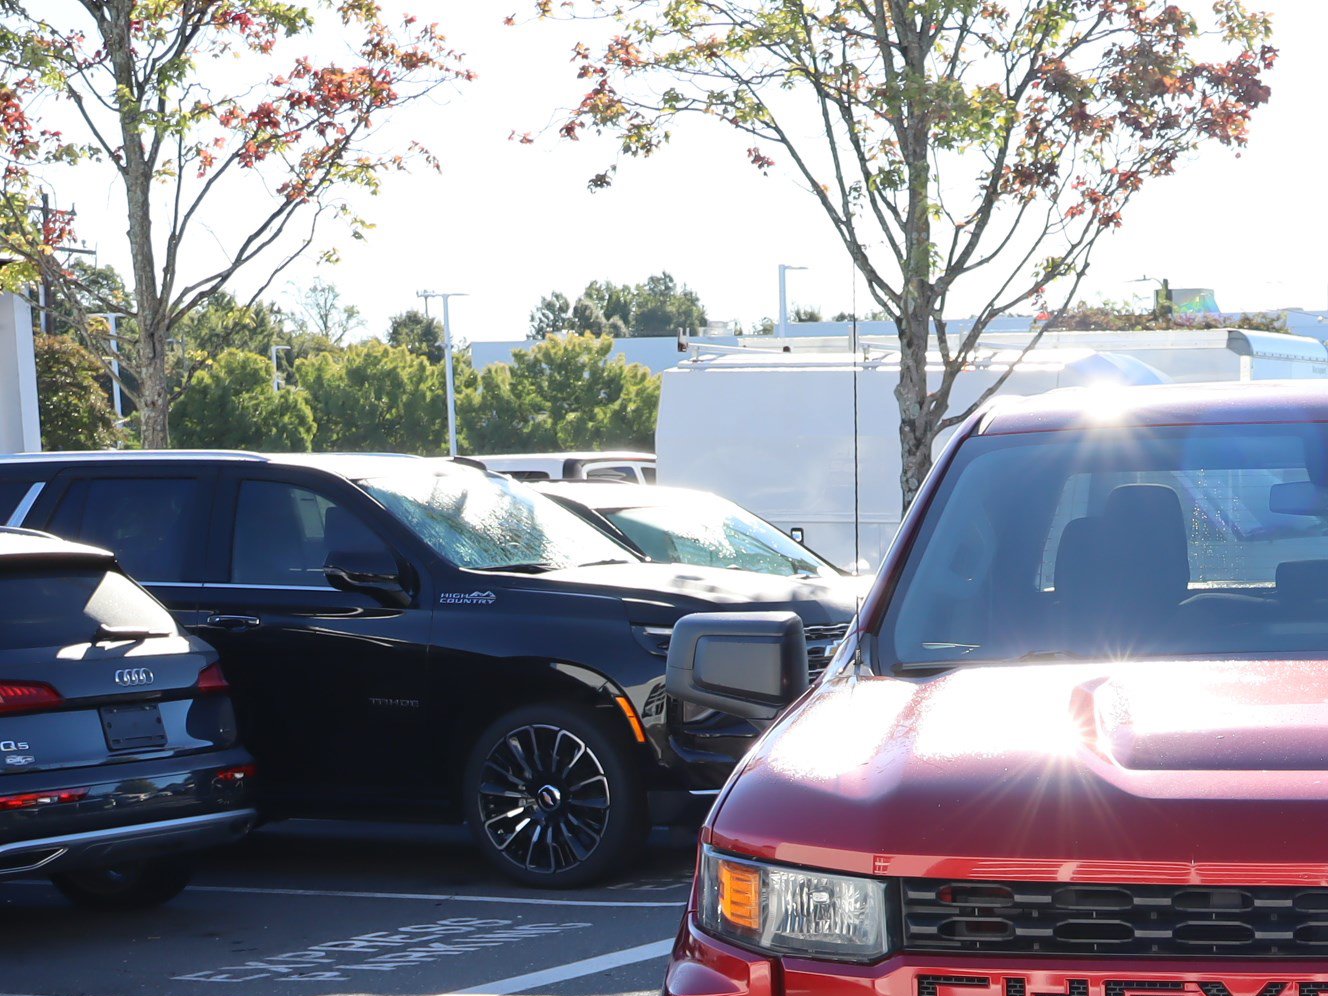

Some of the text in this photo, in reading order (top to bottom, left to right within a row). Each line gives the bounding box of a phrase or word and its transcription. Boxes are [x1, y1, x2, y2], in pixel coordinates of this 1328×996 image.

[0, 741, 29, 751] Q5
[169, 917, 512, 983] EXPRESS
[273, 922, 594, 981] PARKING
